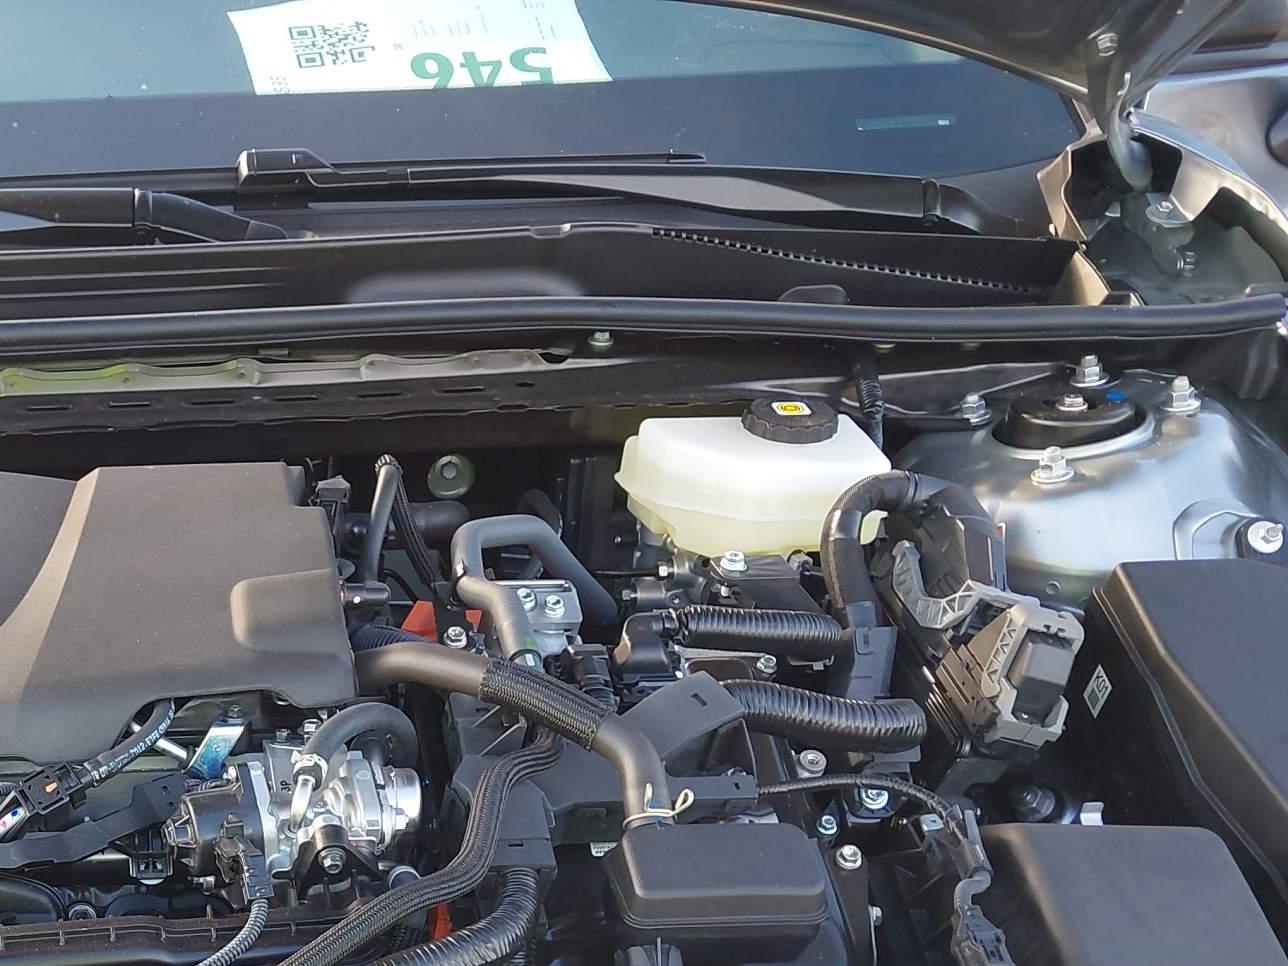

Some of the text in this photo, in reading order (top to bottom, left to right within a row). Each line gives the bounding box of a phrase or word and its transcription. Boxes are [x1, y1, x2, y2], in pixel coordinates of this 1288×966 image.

[411, 47, 554, 89] 546
[1094, 669, 1109, 698] K01
[280, 780, 291, 792] 3P
